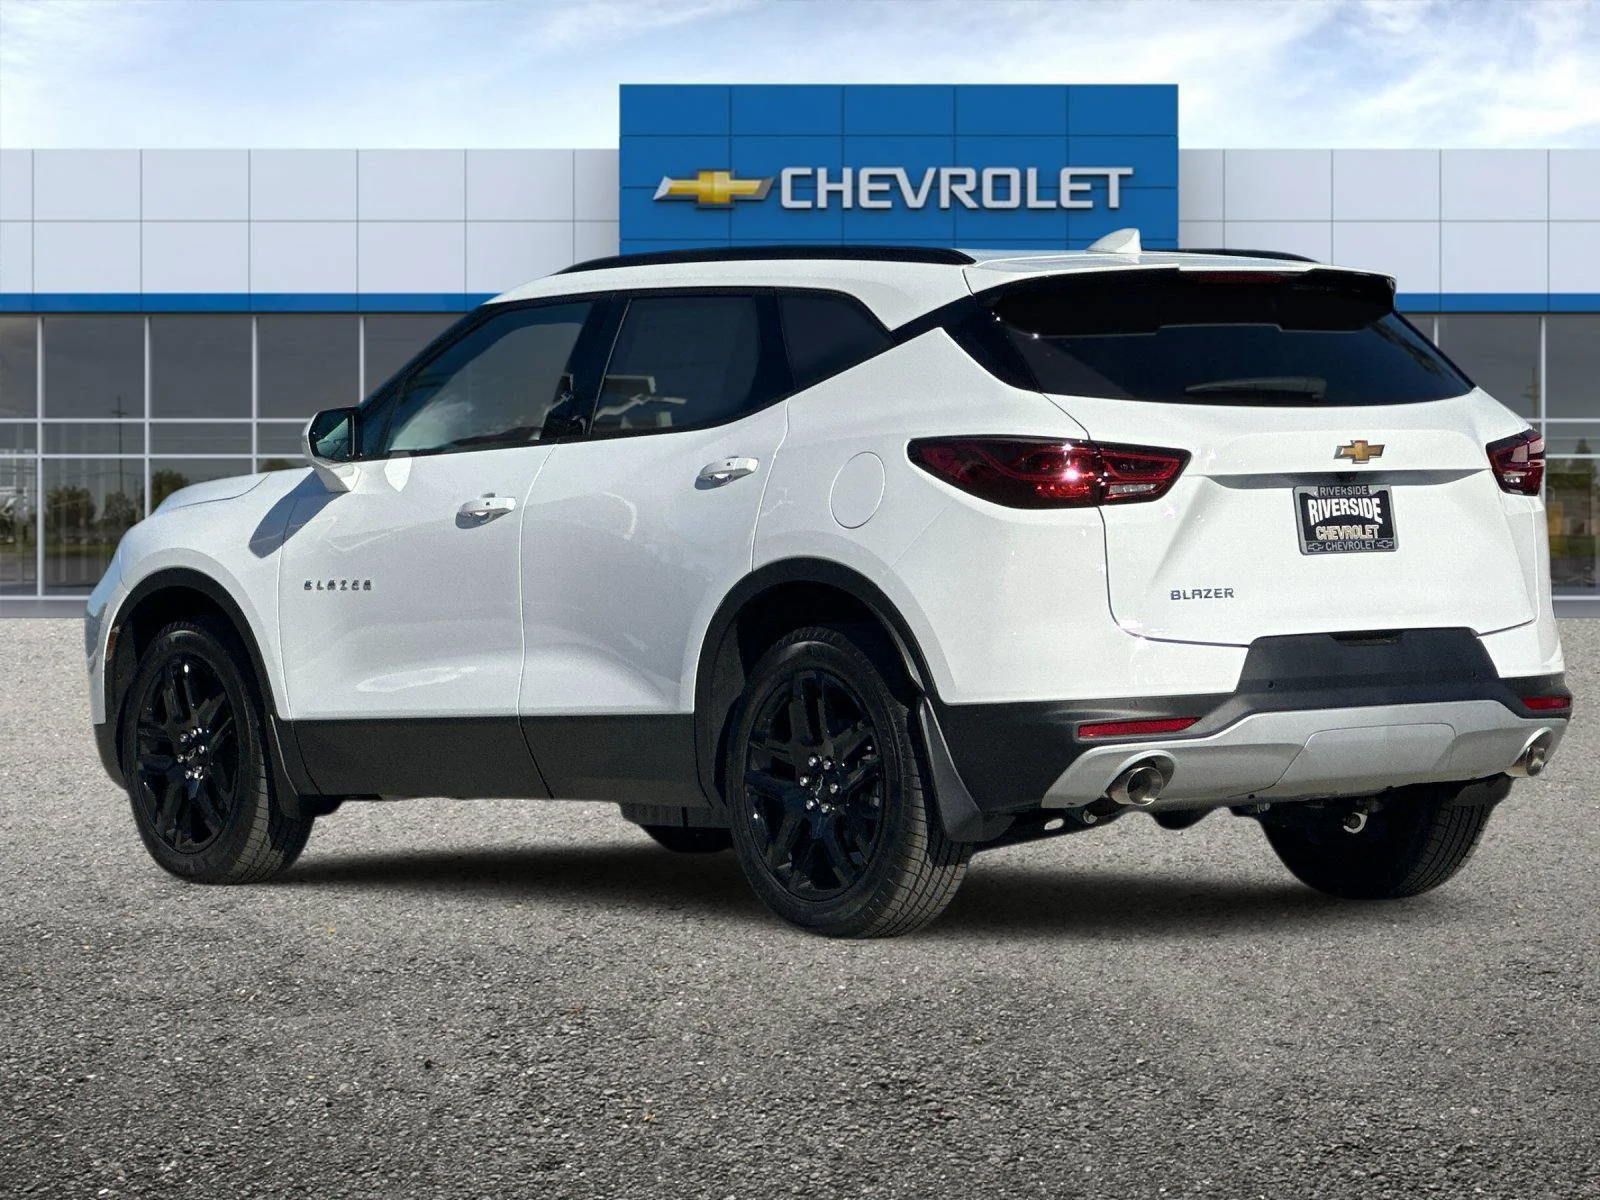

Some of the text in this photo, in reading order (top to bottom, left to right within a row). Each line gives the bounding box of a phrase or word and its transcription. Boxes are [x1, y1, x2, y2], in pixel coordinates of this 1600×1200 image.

[780, 167, 1133, 209] CHEVROLET
[1320, 486, 1368, 496] RIVERSIDE
[1307, 498, 1384, 526] RIVERSIDE
[1315, 524, 1380, 541] CHEVROLET
[1325, 540, 1377, 551] CHEVROLET
[303, 579, 372, 591] BLAZER
[1170, 588, 1235, 601] BLAZER
